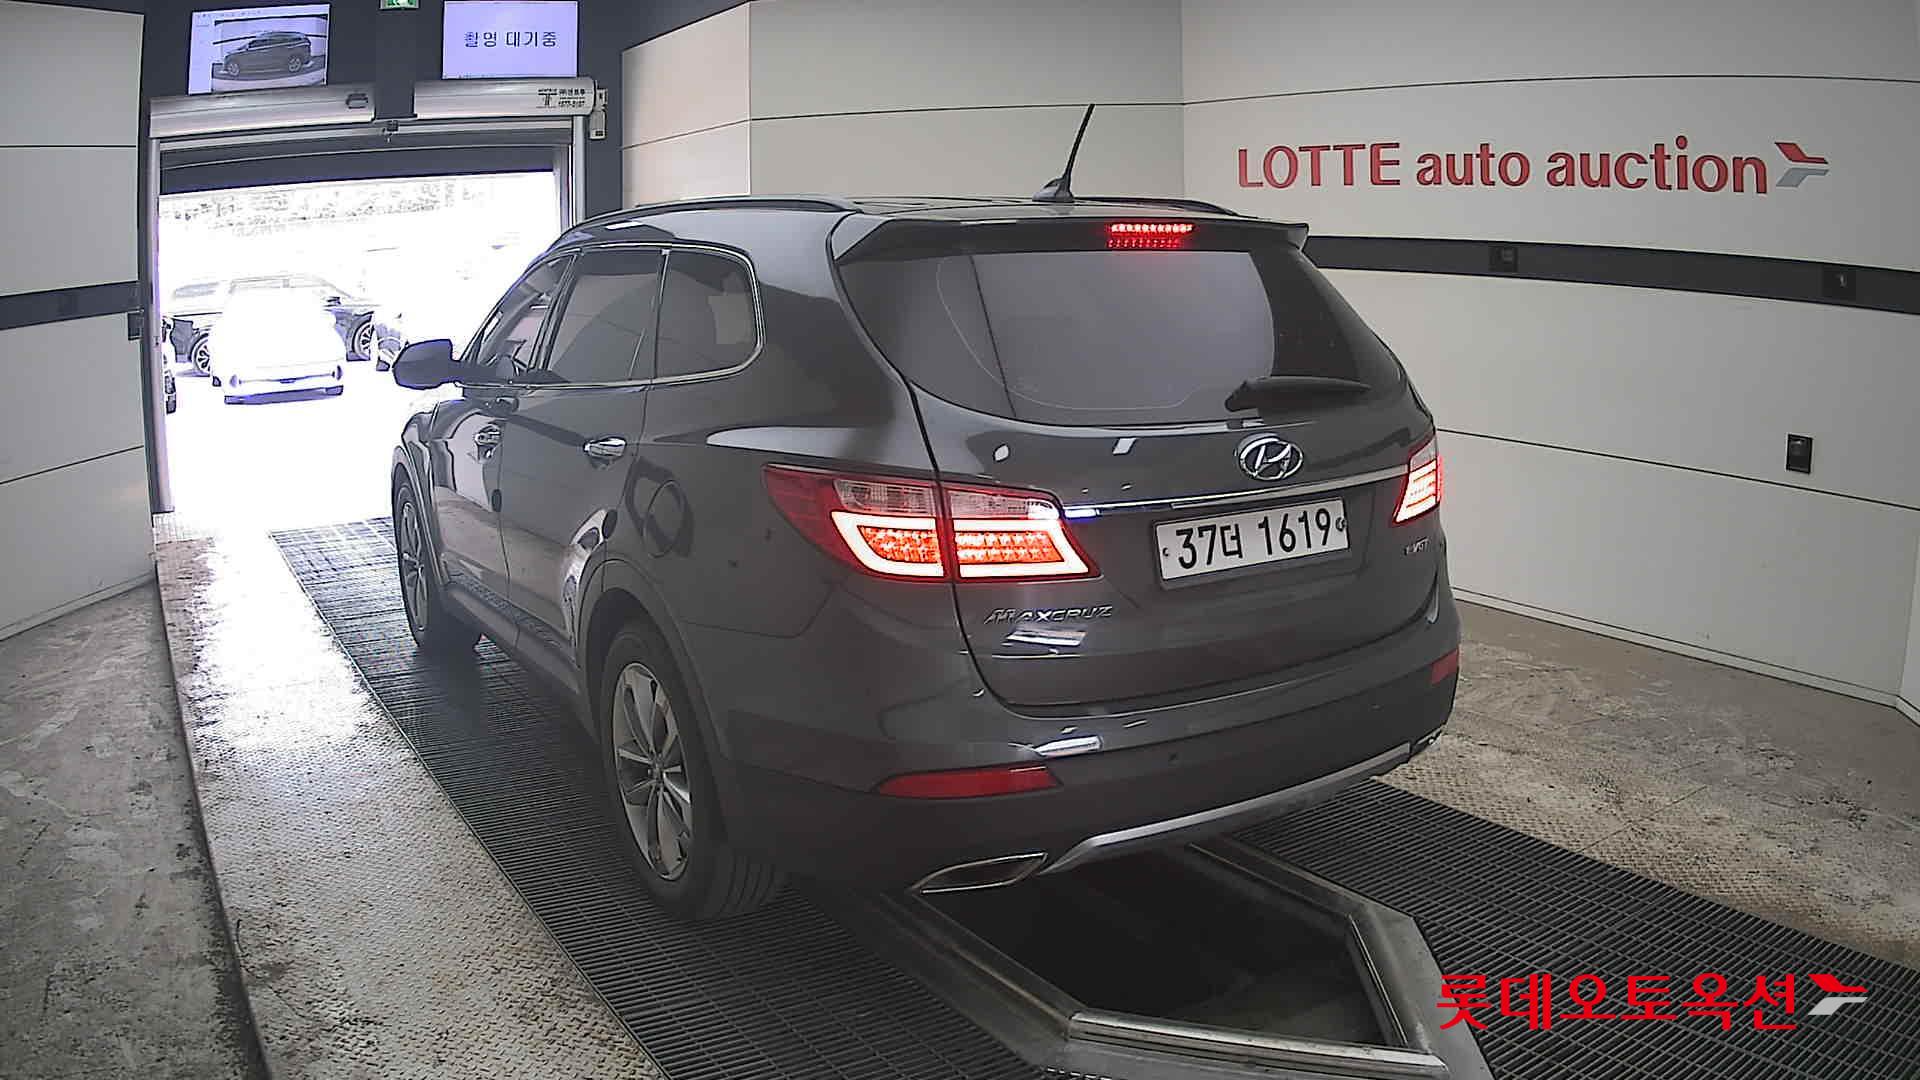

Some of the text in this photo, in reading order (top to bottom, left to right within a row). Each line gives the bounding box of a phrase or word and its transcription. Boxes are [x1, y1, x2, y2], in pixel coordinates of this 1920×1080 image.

[505, 31, 557, 48] 대기중
[1238, 135, 1768, 194] LOTTE auto auction
[1175, 507, 1331, 570] 37더 1619
[984, 604, 1113, 625] MAXCRUZ
